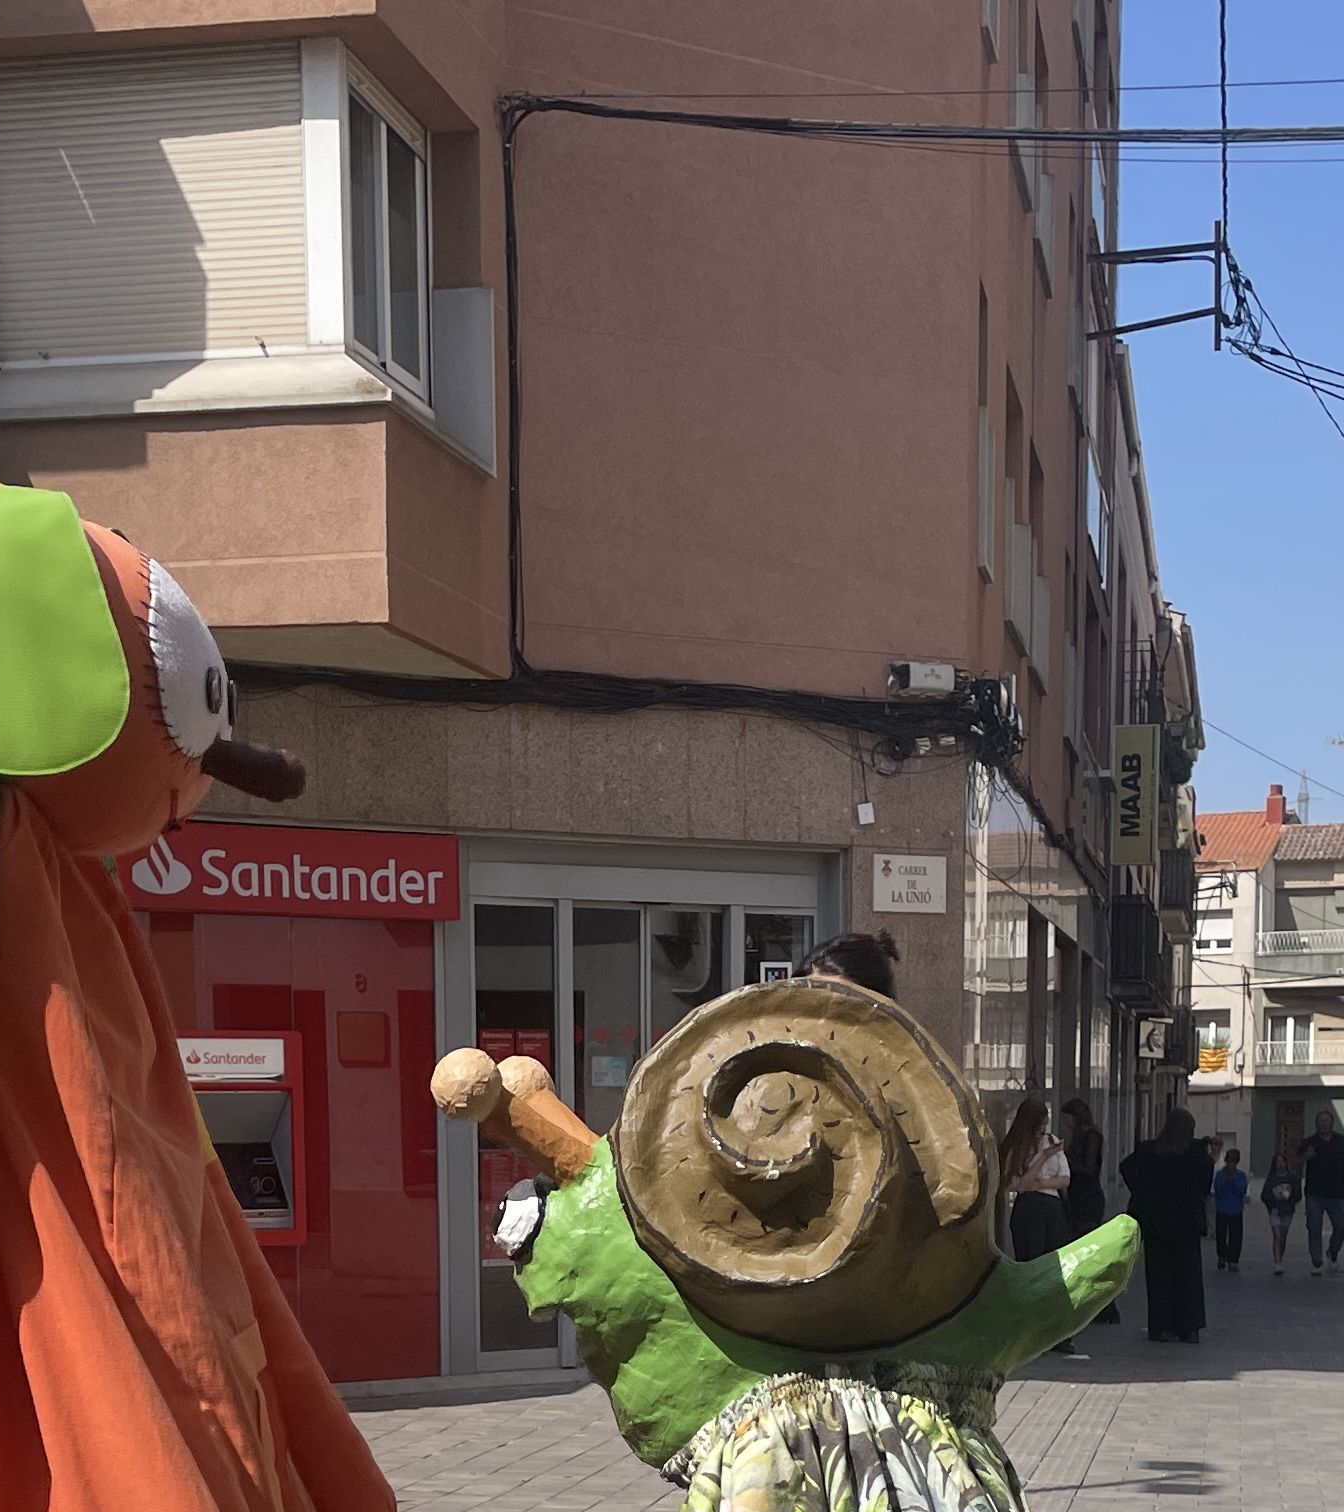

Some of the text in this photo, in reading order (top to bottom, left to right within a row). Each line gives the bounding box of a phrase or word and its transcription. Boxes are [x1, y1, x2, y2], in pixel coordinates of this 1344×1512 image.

[1120, 753, 1141, 837] MAAB
[201, 848, 444, 905] Santander
[898, 865, 928, 876] CARRER
[906, 880, 917, 890] DE
[891, 887, 932, 904] LA UNIÓ
[203, 1051, 266, 1065] Santander
